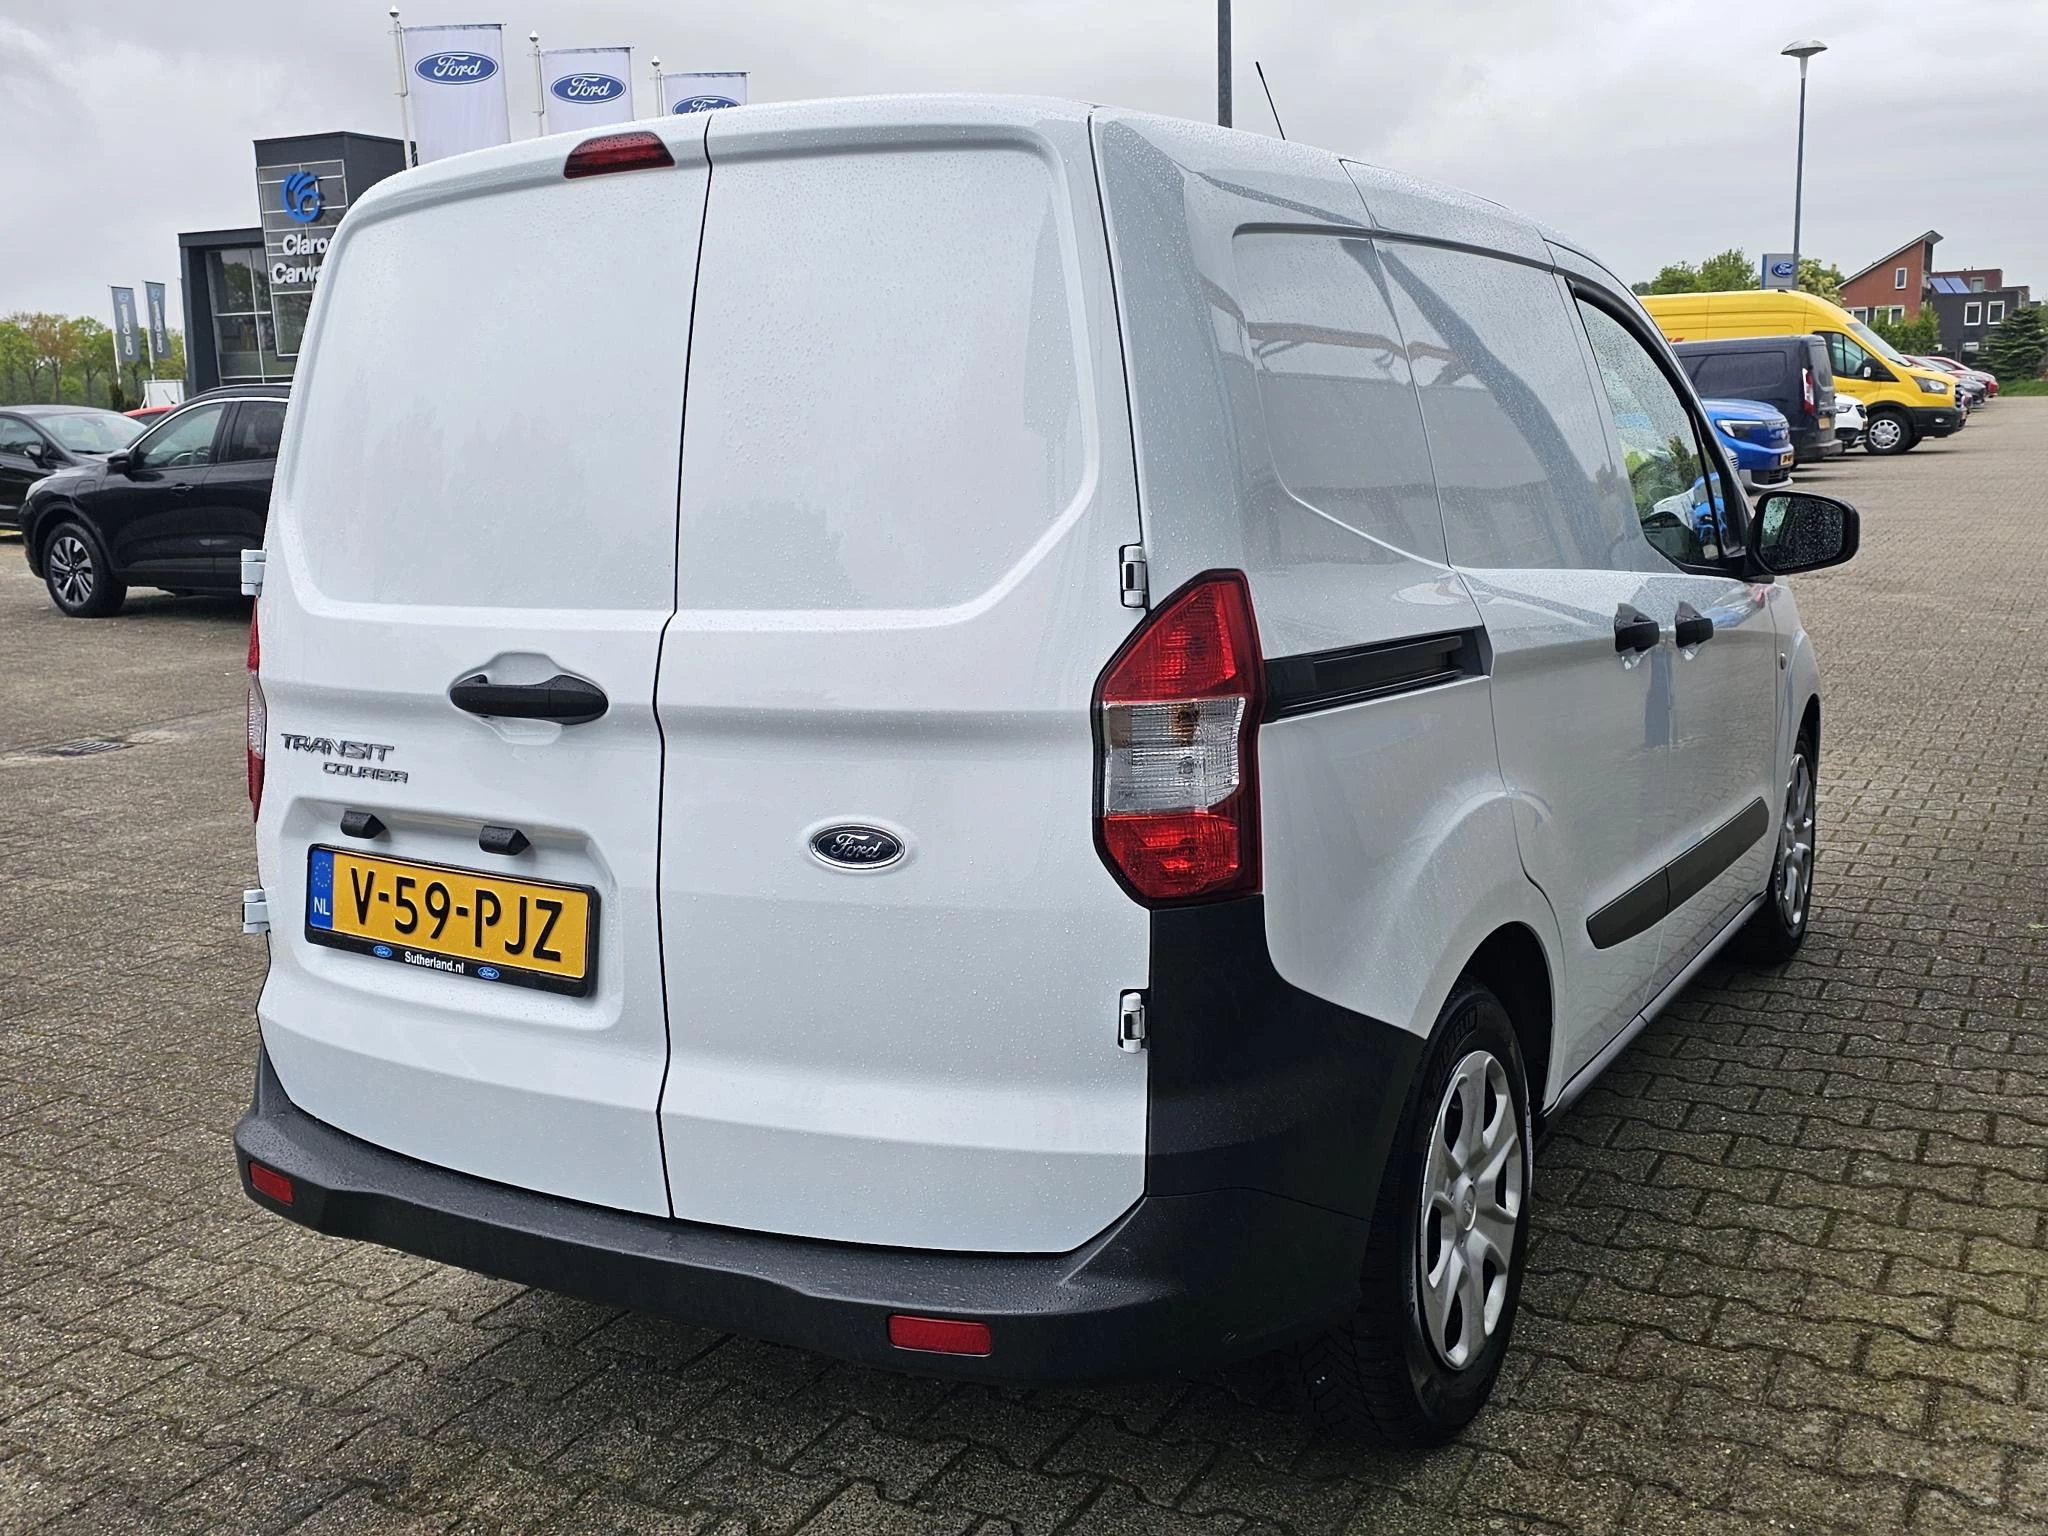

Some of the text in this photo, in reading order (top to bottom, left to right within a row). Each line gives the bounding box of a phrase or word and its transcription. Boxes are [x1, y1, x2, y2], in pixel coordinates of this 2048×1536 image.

[433, 54, 482, 78] Ford
[567, 76, 611, 98] Ford
[282, 233, 329, 256] Claro
[280, 733, 395, 762] TRANSIT
[322, 761, 409, 784] COURIER
[830, 833, 883, 858] Ford
[313, 896, 331, 916] NL
[350, 866, 563, 962] V-59-PJZ
[404, 950, 465, 975] Sutherland.nl
